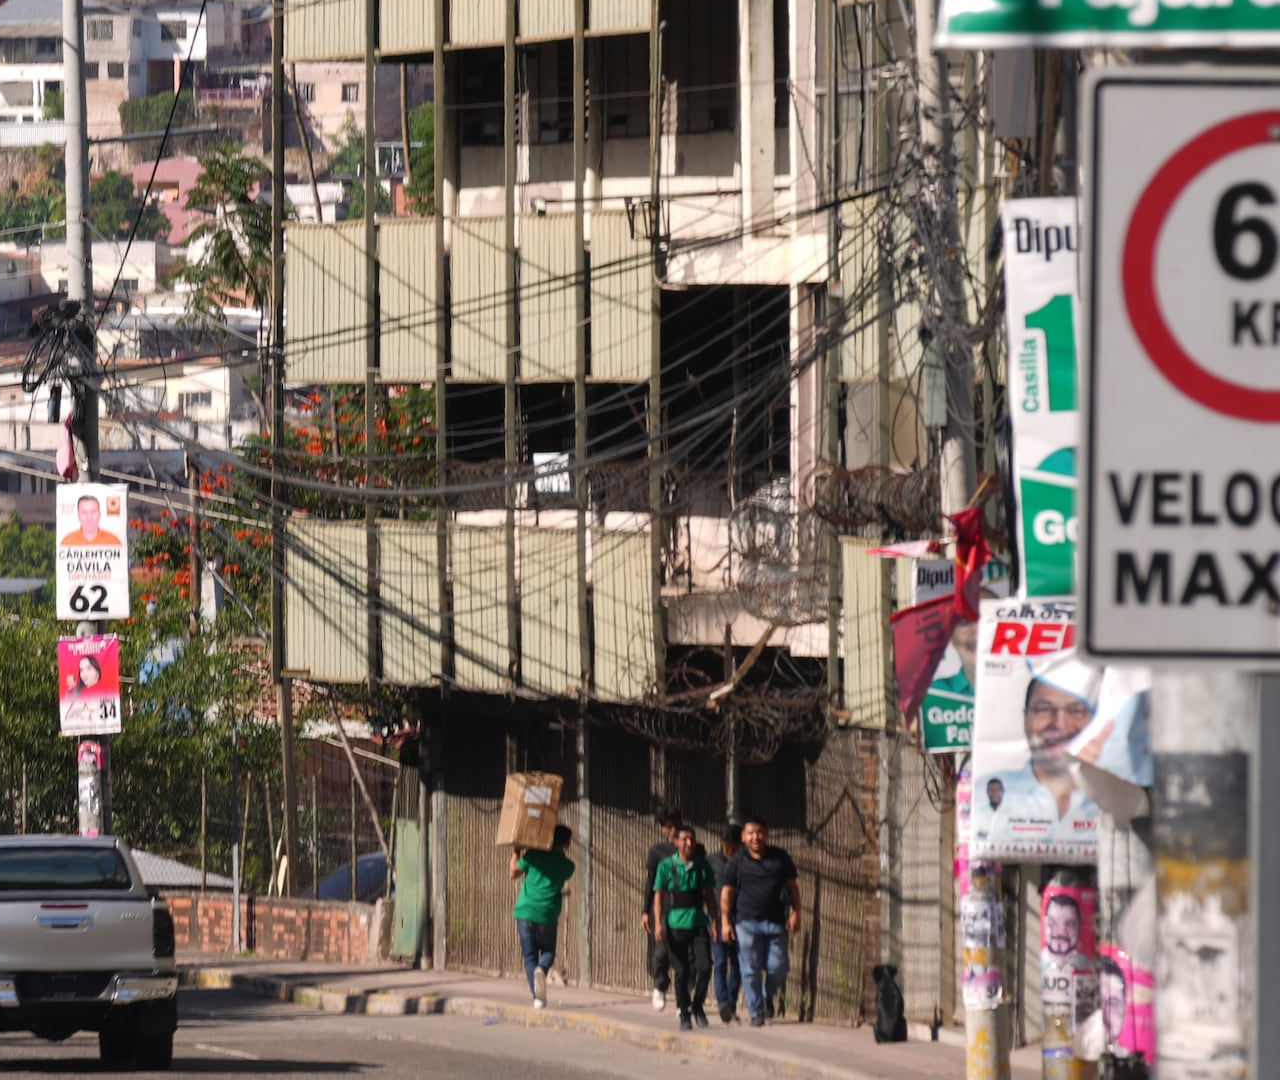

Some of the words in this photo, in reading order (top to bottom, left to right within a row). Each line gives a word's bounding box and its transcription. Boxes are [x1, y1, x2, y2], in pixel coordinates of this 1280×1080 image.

[1021, 338, 1040, 413] Casilla
[1025, 293, 1079, 412] 1
[67, 560, 112, 574] DÁVILA
[69, 584, 110, 614] 62
